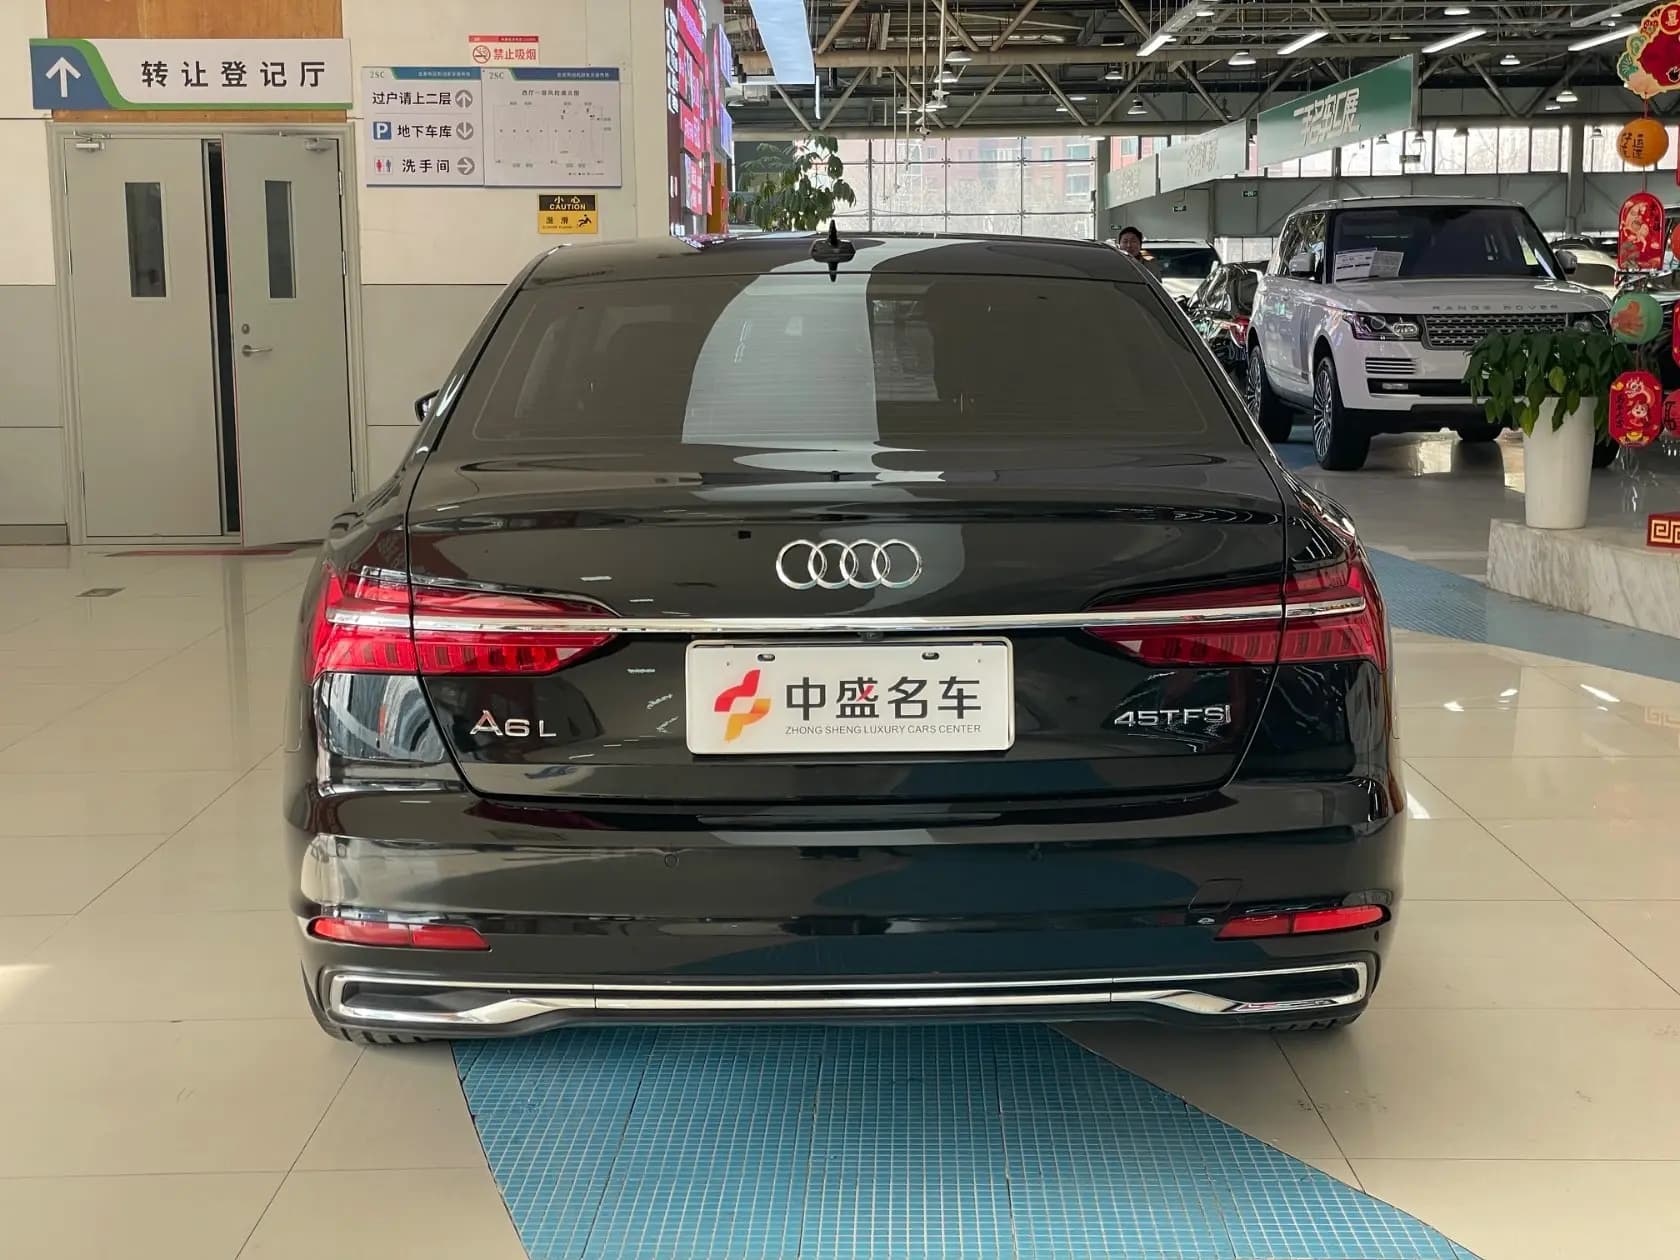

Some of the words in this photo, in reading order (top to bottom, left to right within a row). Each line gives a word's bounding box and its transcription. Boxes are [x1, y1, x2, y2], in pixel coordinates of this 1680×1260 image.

[493, 47, 537, 61] 禁止吸烟
[141, 60, 326, 88] 转让登记厅
[369, 70, 385, 79] 2SC
[372, 91, 452, 105] 过户请上二层
[376, 122, 389, 139] P
[397, 124, 452, 138] 地下车库
[402, 159, 450, 173] 洗手间
[554, 195, 581, 204] 小心
[786, 676, 982, 721] 中盛名车
[785, 726, 823, 735] ZHONG
[825, 725, 862, 735] SHENG
[864, 725, 905, 734] LUXURY
[907, 724, 936, 734] CARS
[938, 724, 982, 734] CENTER
